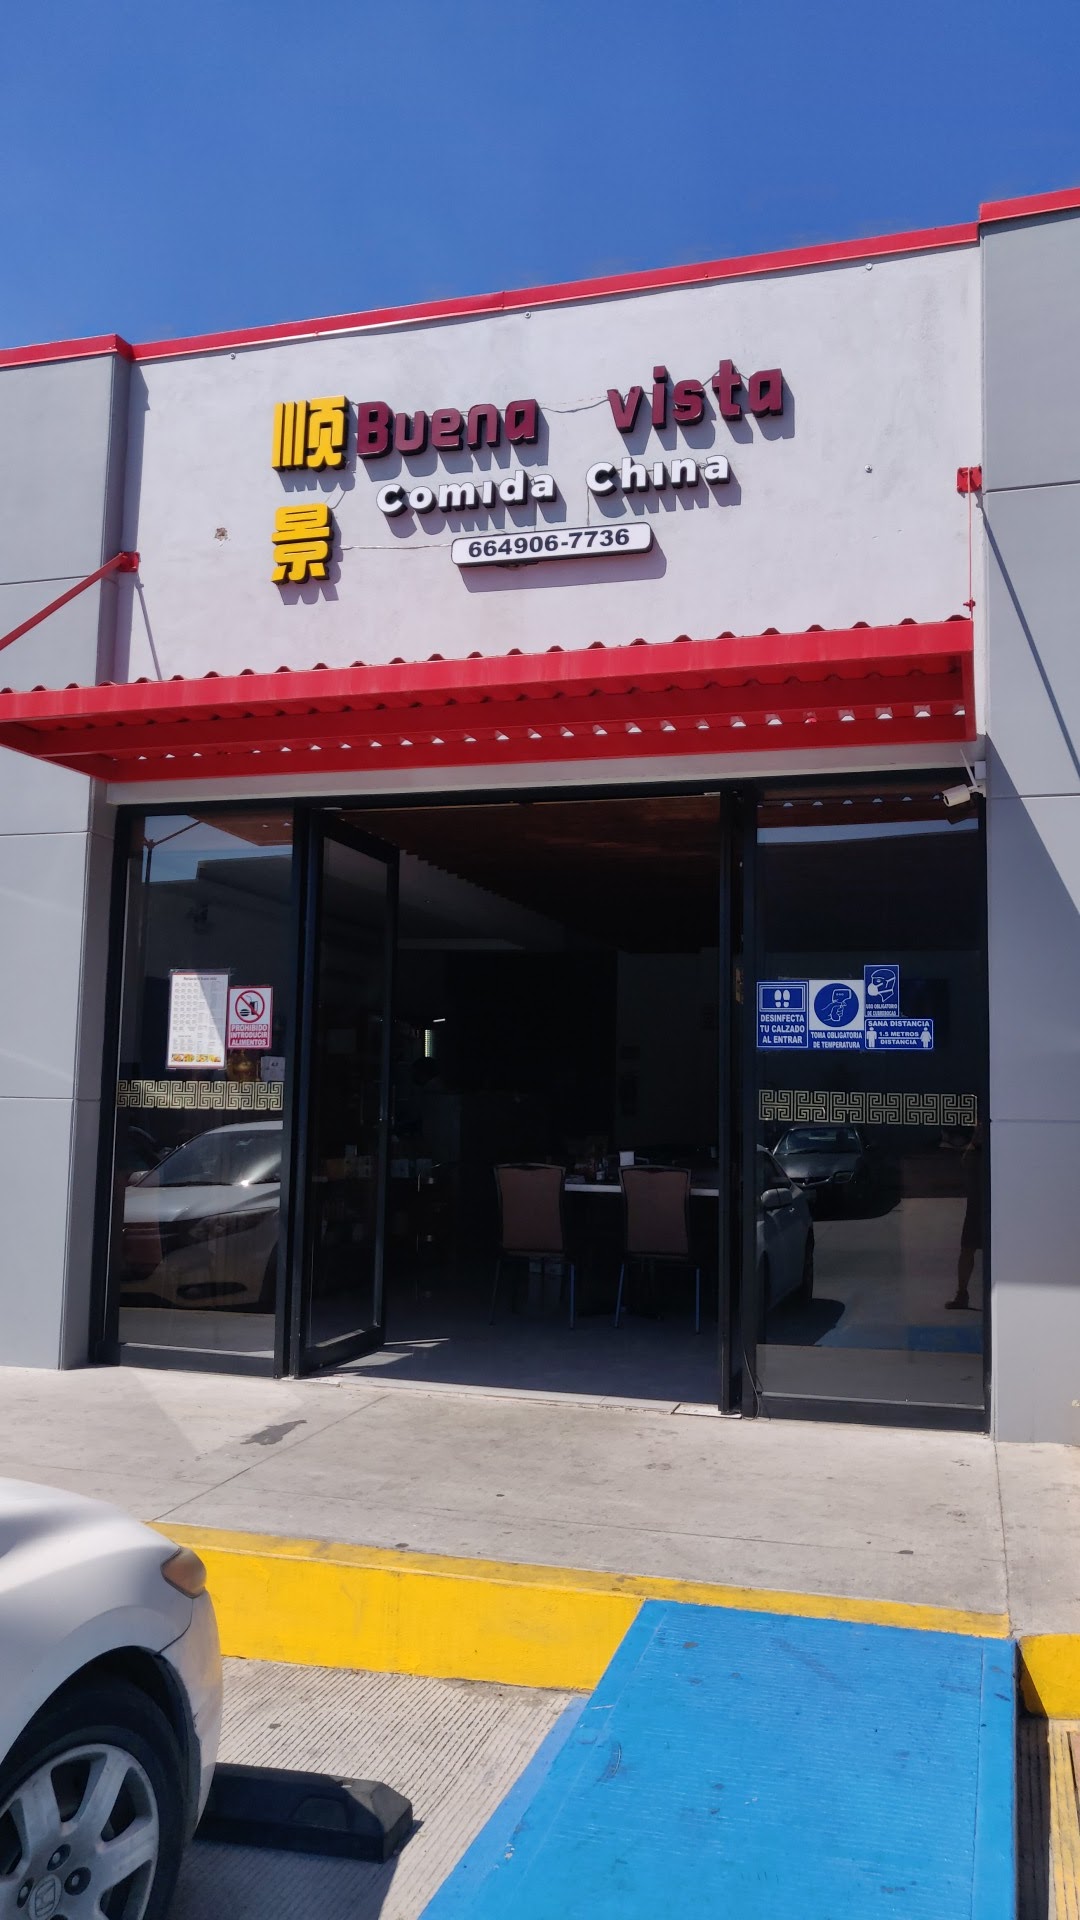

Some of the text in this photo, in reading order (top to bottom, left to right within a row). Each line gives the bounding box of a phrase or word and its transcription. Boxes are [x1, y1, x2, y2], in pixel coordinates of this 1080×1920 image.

[357, 359, 784, 459] Buena vista
[376, 455, 731, 517] Comida China
[468, 527, 630, 558] 664906-7736
[760, 1014, 804, 1022] DESINFECTA
